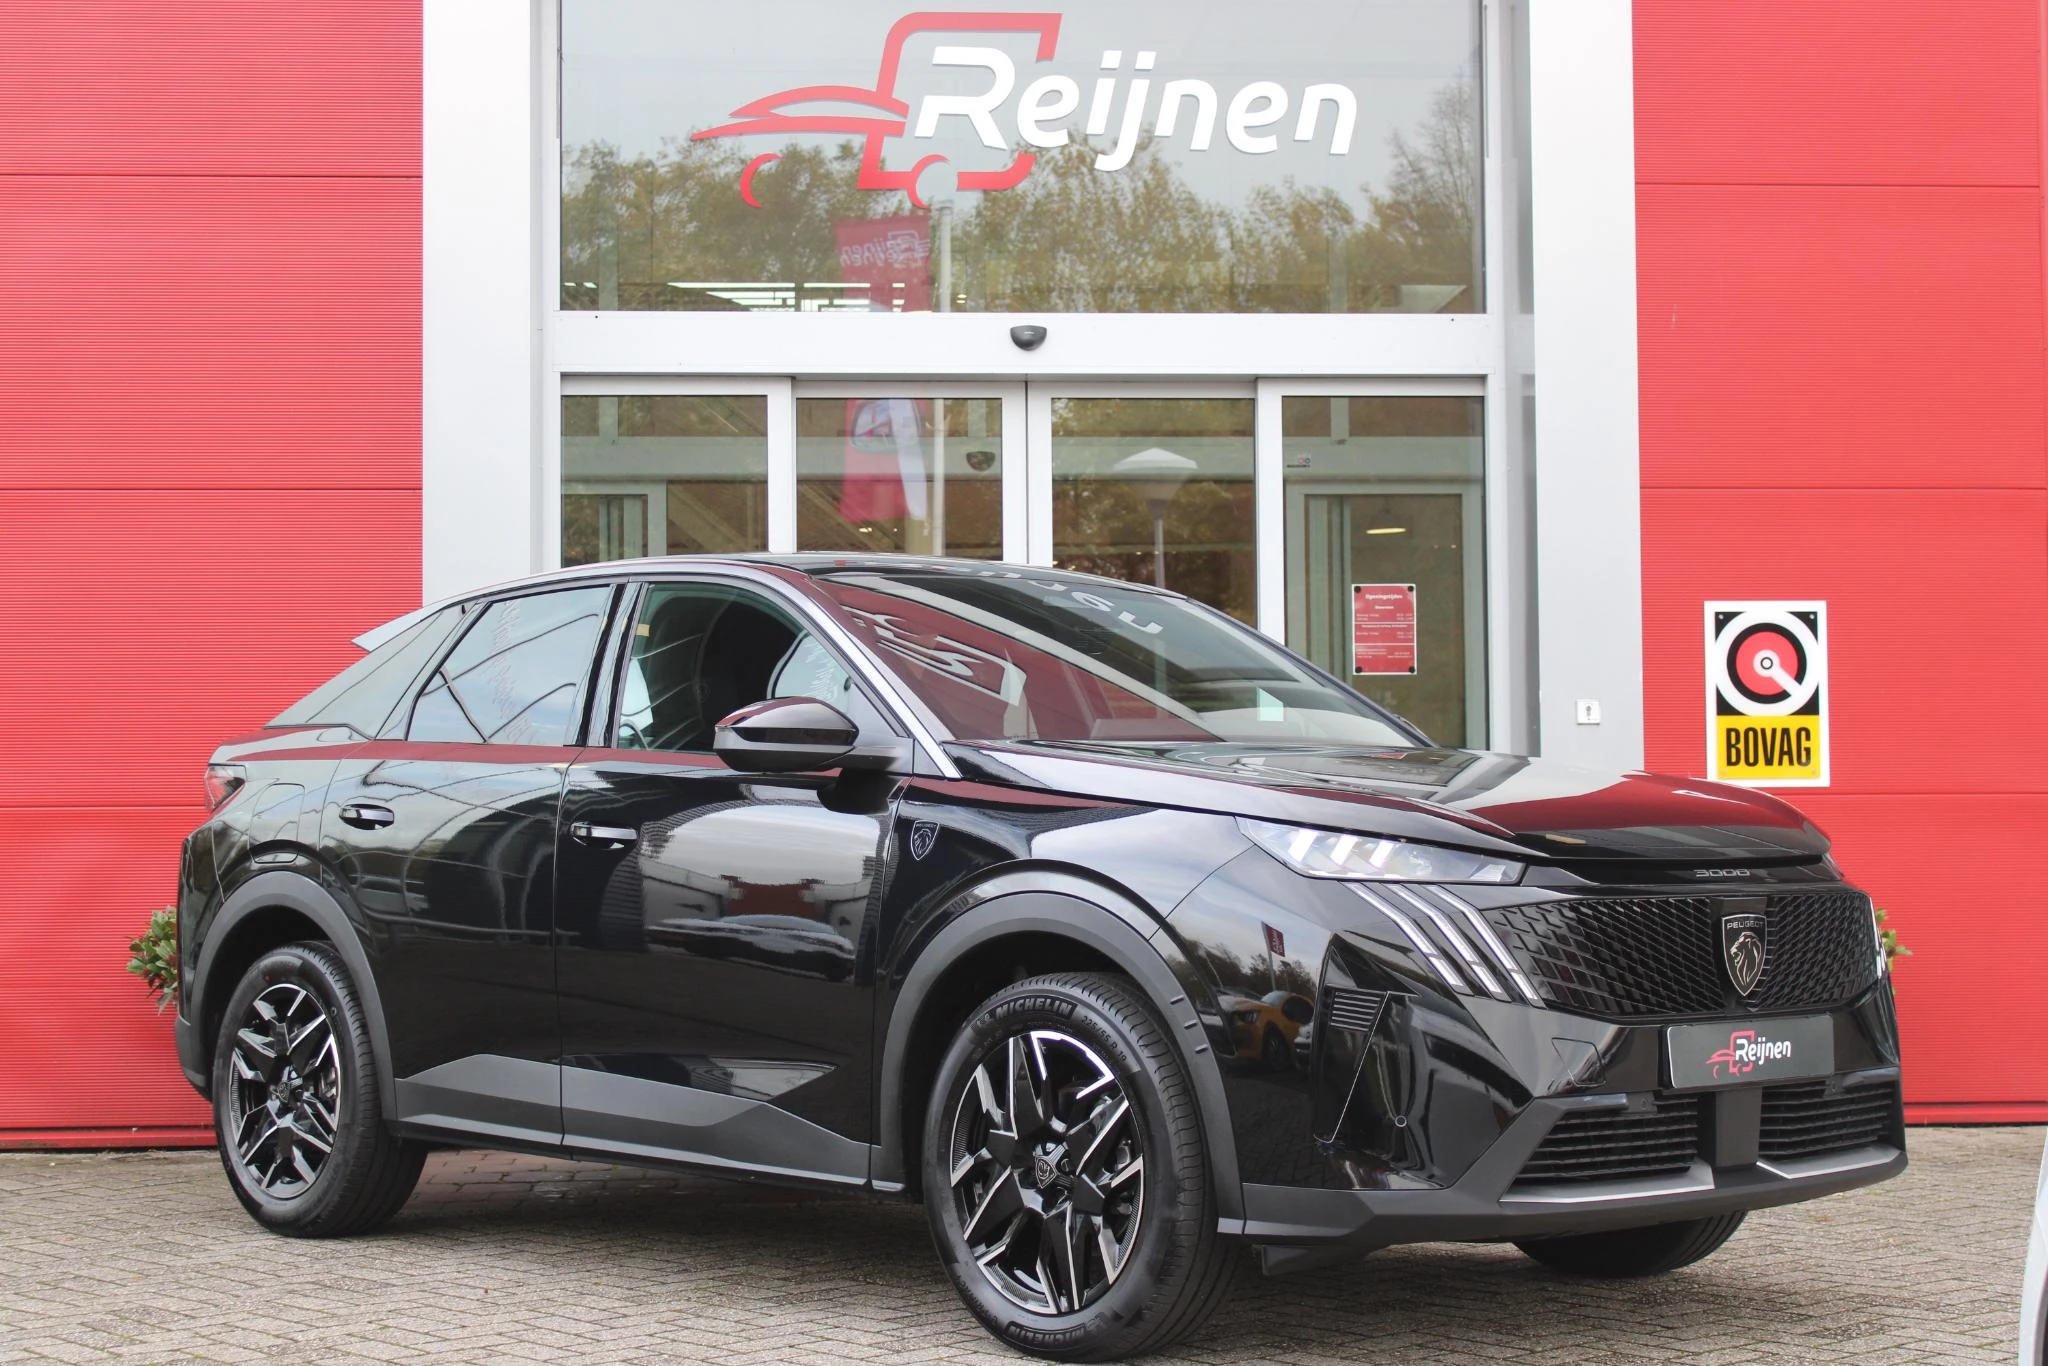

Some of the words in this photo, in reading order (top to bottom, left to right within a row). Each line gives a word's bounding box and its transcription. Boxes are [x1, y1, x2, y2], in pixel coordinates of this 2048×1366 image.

[914, 46, 1358, 172] Reijnen
[1726, 727, 1812, 767] BOVAG
[1694, 868, 1750, 877] 3008
[1726, 920, 1765, 930] PEUGEOT
[995, 998, 1072, 1019] MICHELIN
[1081, 1015, 1112, 1043] 225/55
[1735, 1037, 1792, 1066] Reijnen
